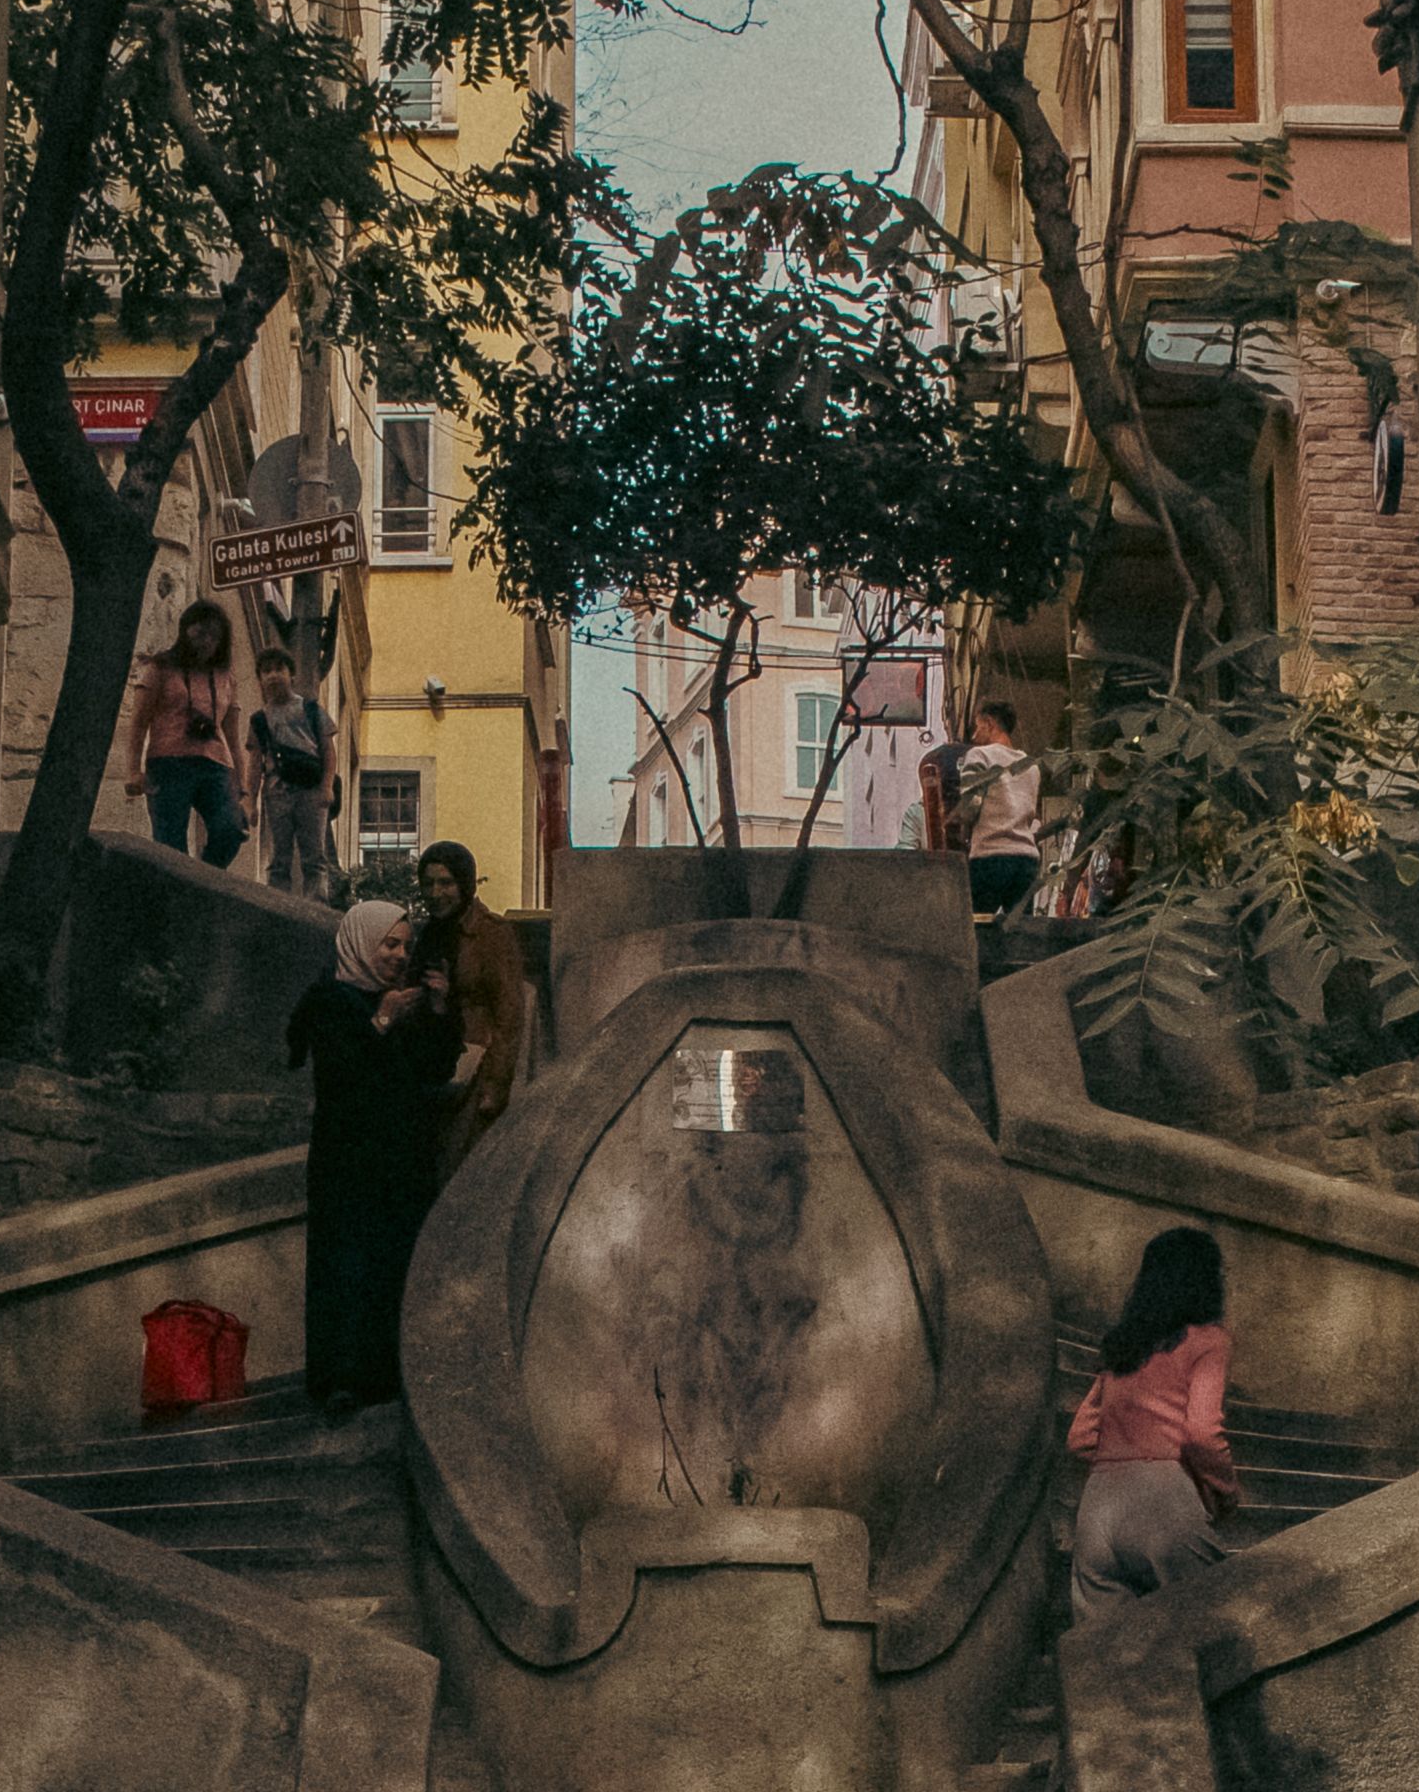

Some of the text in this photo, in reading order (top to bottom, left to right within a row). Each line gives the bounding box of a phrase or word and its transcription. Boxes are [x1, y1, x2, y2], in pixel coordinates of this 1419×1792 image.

[72, 398, 146, 416] RT ÇINAR
[214, 524, 329, 565] Galata Kulesi
[276, 550, 321, 570] Tower)
